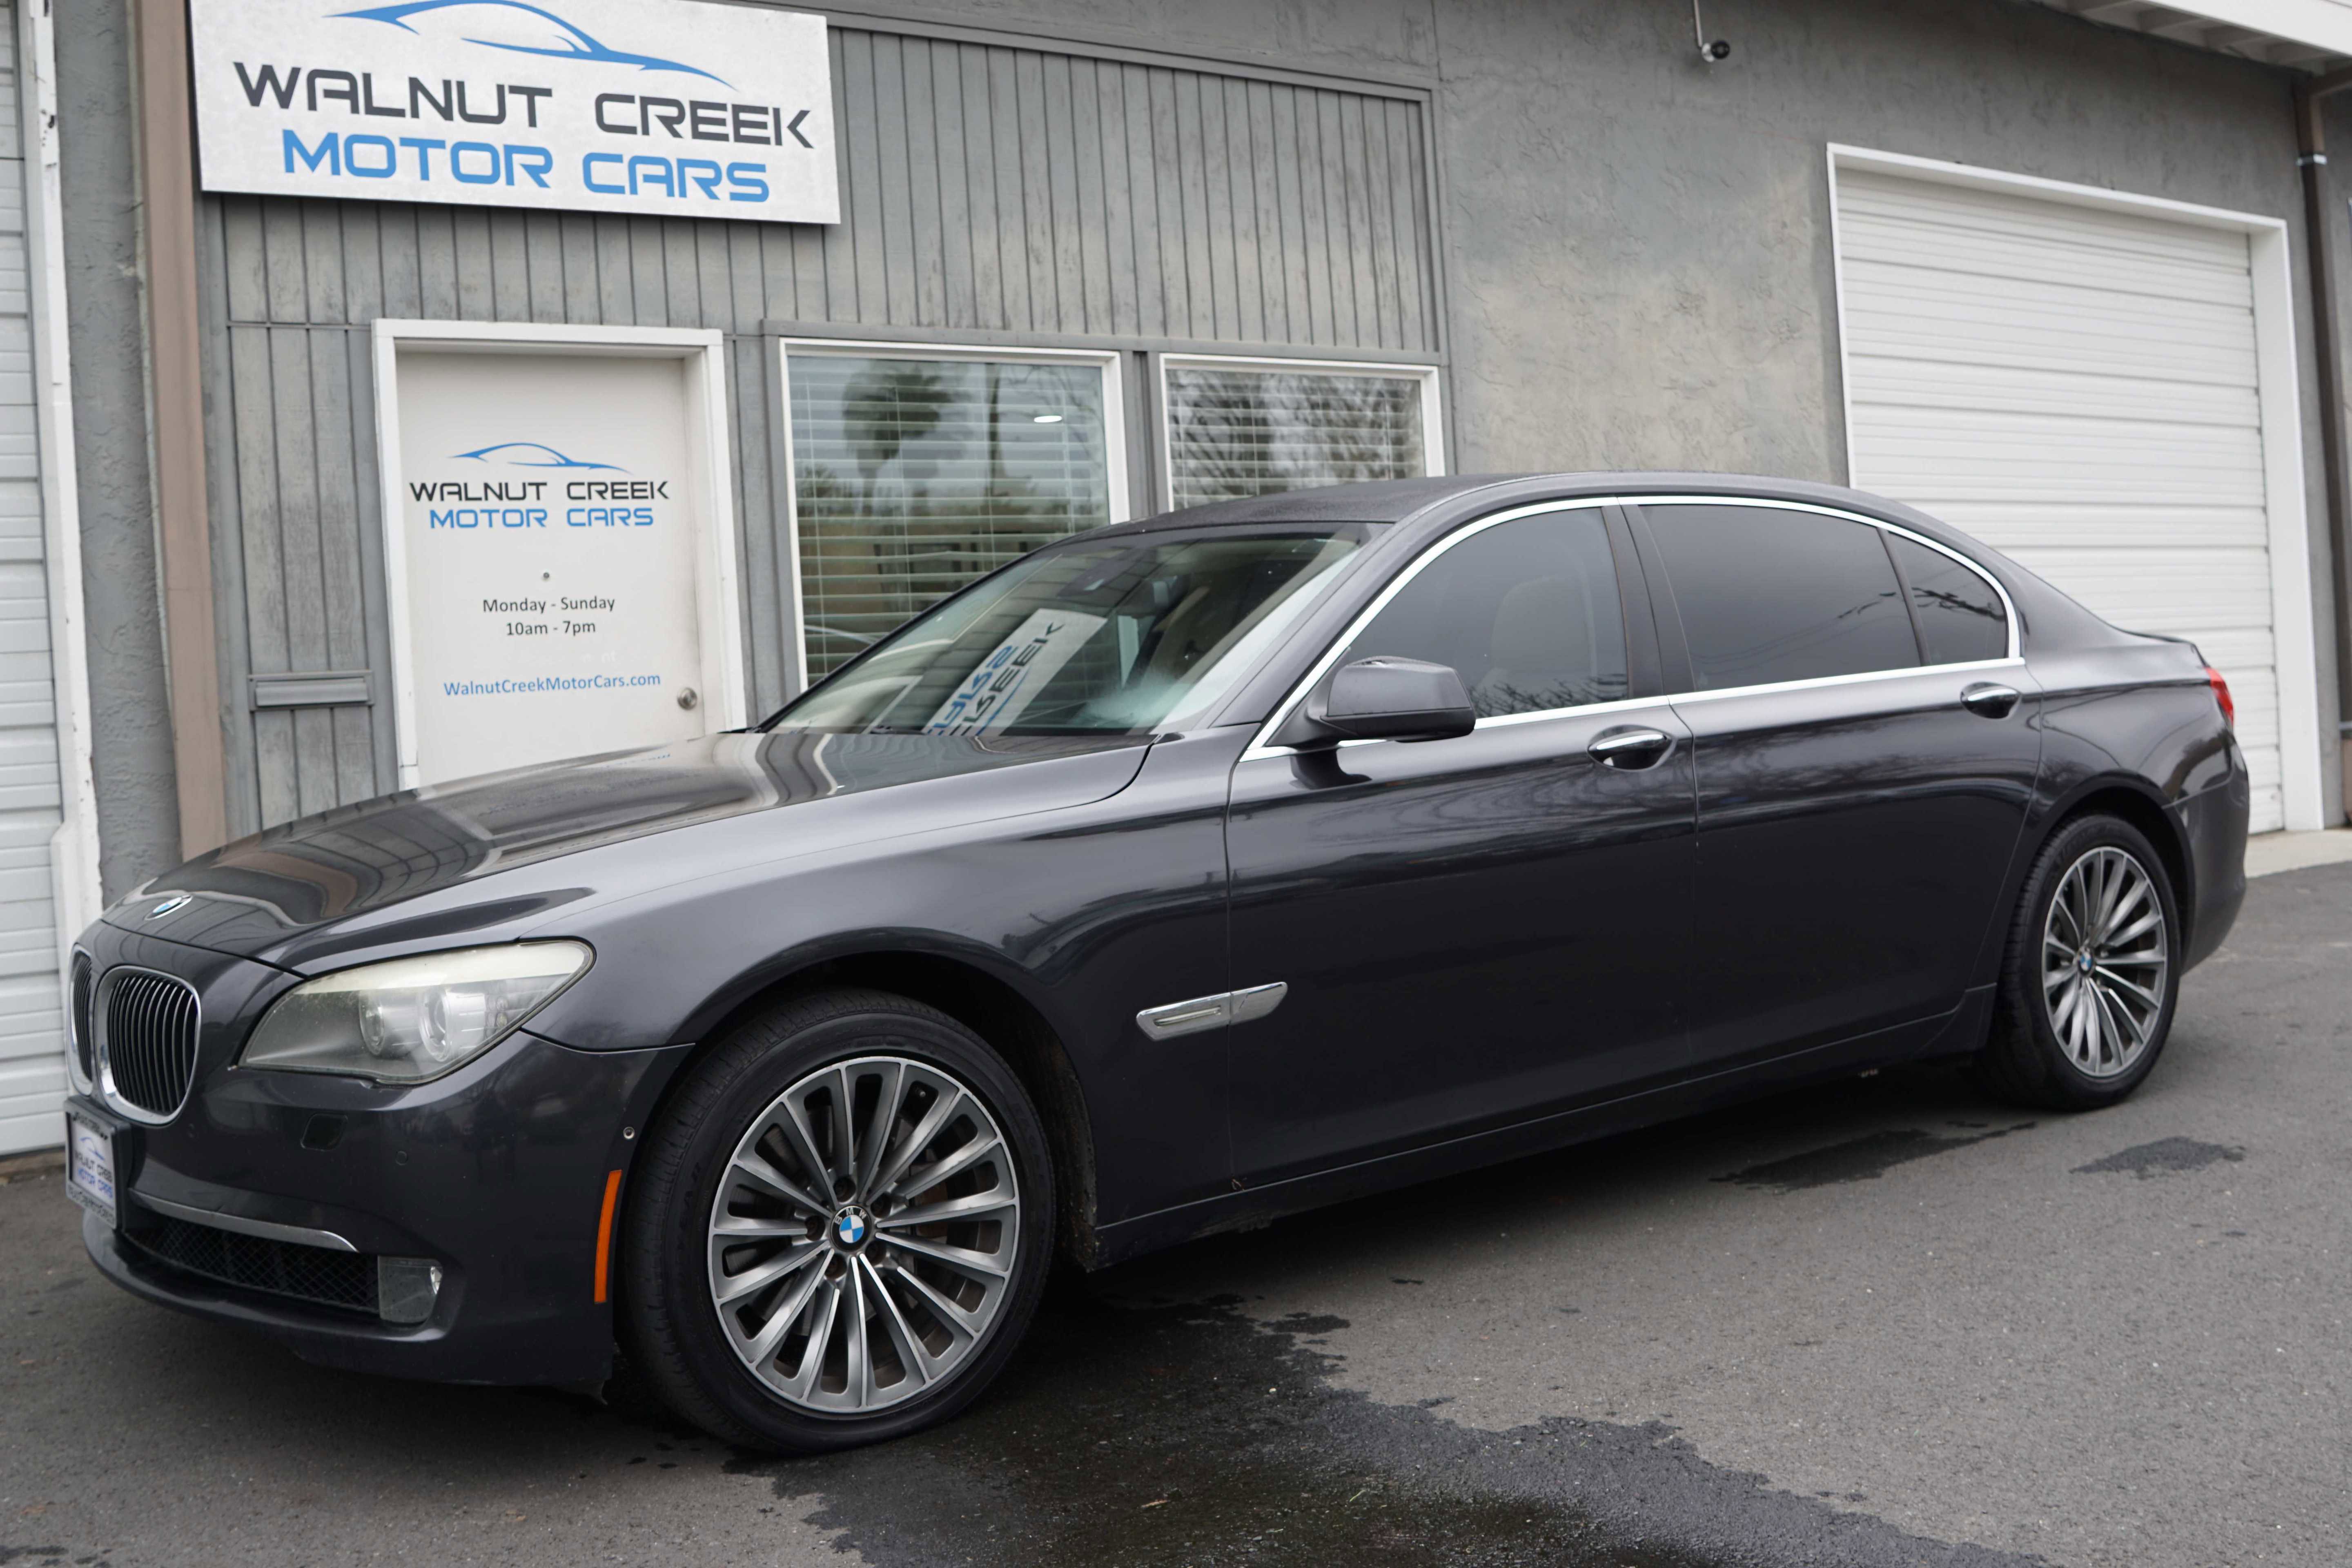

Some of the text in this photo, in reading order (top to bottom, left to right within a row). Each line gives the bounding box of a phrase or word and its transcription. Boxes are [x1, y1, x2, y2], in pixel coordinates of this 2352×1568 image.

[233, 62, 813, 149] WALNUT CREEK
[283, 129, 769, 203] MOTOR CARS
[409, 481, 669, 502] WALNUT CREEK
[430, 508, 654, 528] MOTOR CARS
[483, 598, 546, 614] Monday
[561, 596, 615, 612] Sunday
[506, 622, 548, 636] 10am
[563, 621, 596, 637] 7pm
[443, 673, 661, 696] WalnutCreekMotorCars.com
[834, 1207, 867, 1225] BMW
